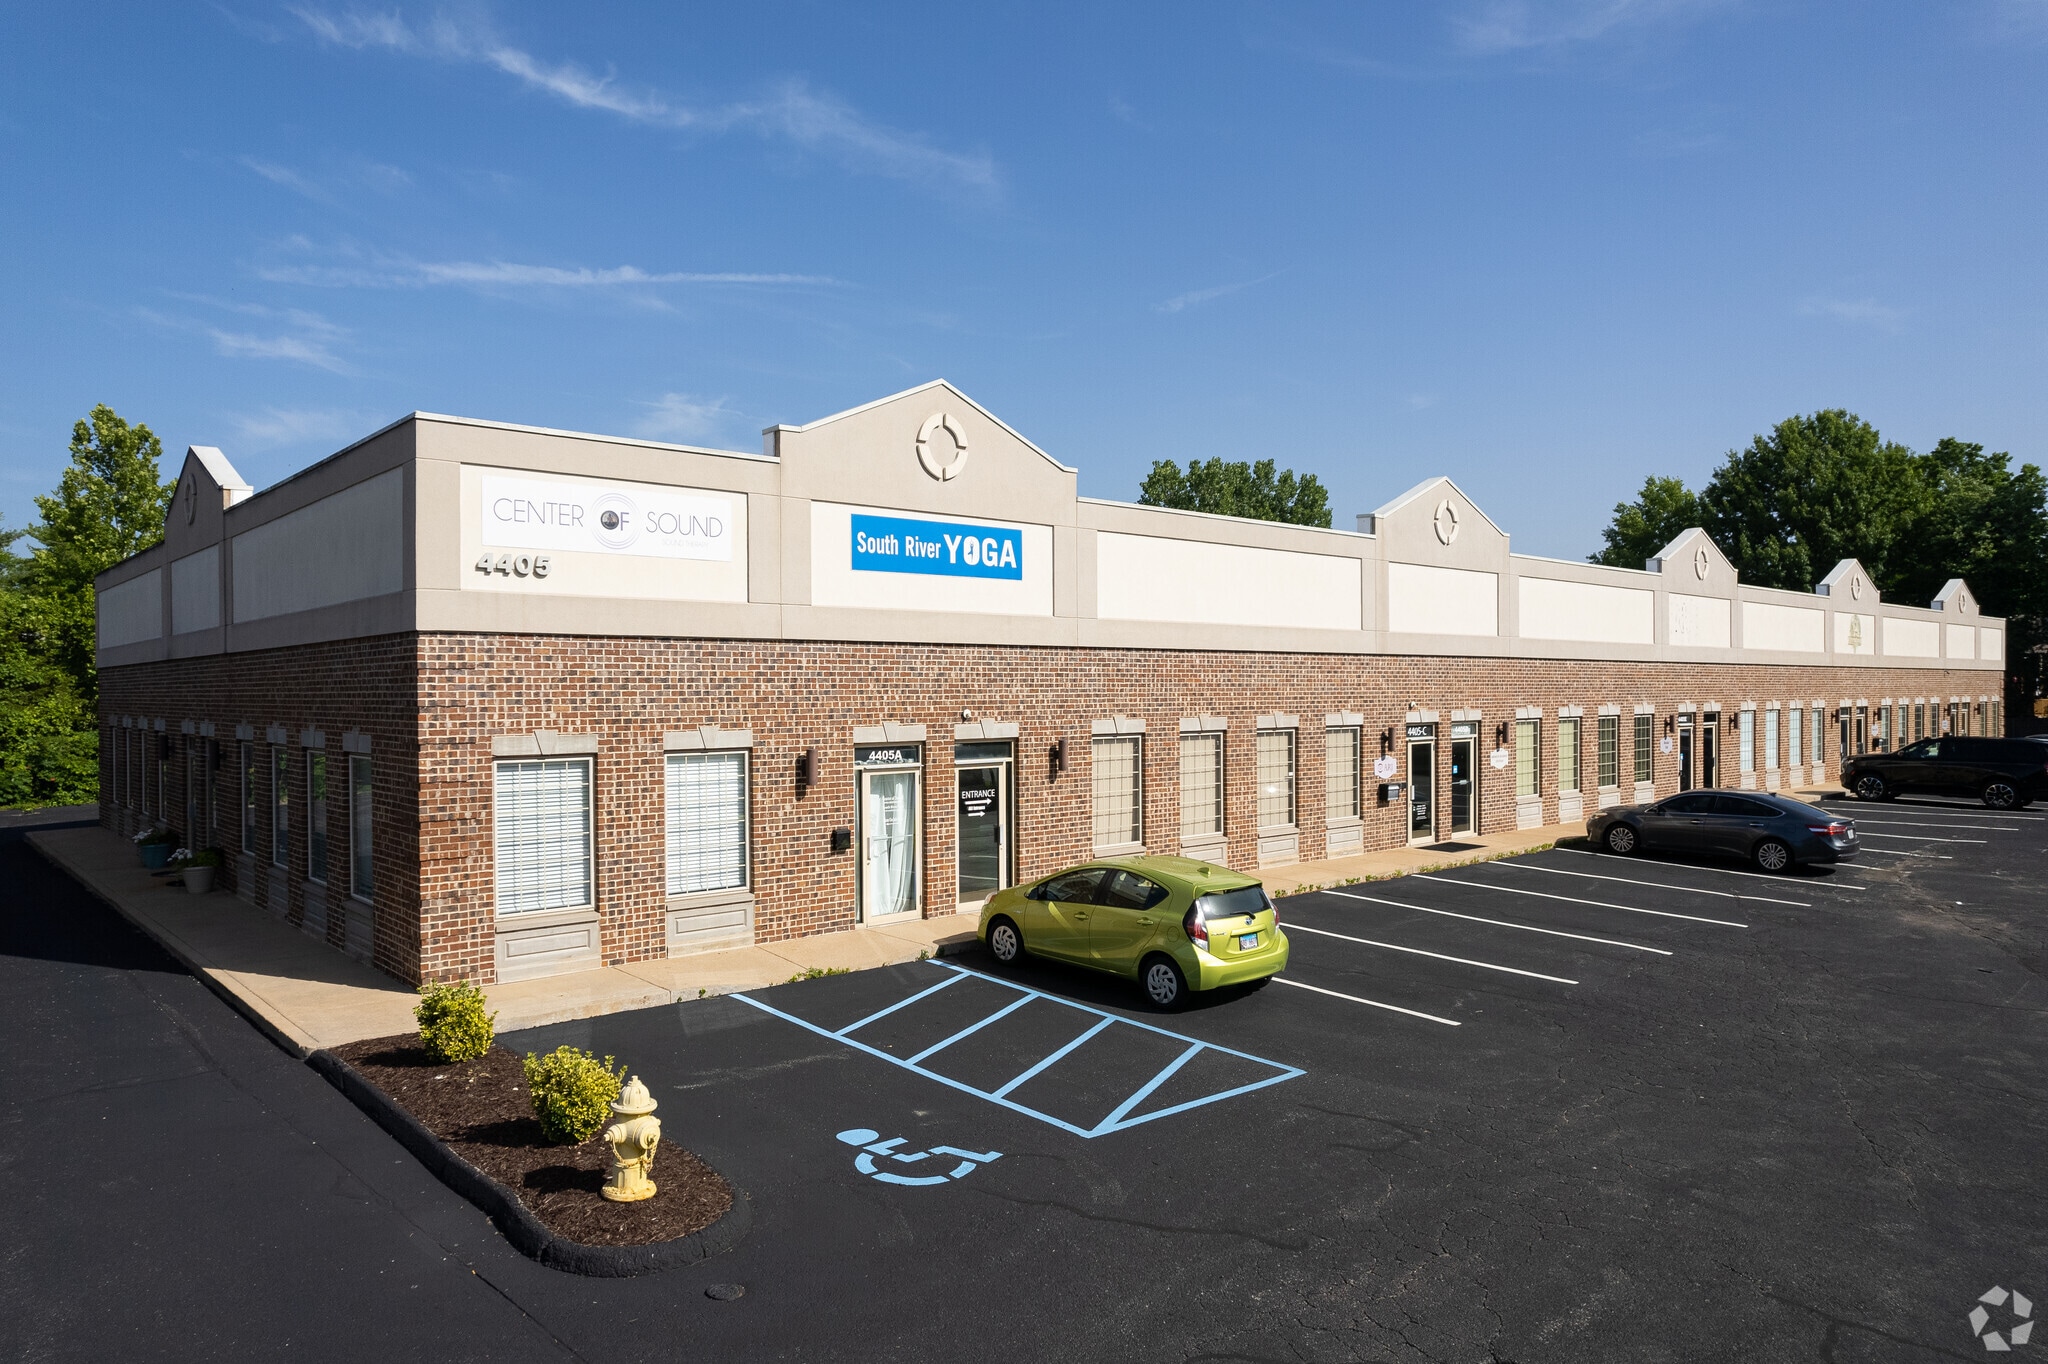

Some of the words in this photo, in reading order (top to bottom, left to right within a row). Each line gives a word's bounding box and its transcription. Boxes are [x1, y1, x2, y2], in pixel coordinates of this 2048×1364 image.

[493, 497, 585, 528] CENTER
[645, 511, 723, 538] SOUND
[856, 531, 899, 556] South
[905, 535, 942, 559] River
[943, 533, 1018, 569] YOGA
[475, 552, 552, 579] 4405
[1407, 726, 1427, 736] 4405-C
[868, 749, 903, 763] 4405A
[961, 788, 996, 800] ENTRANCE
